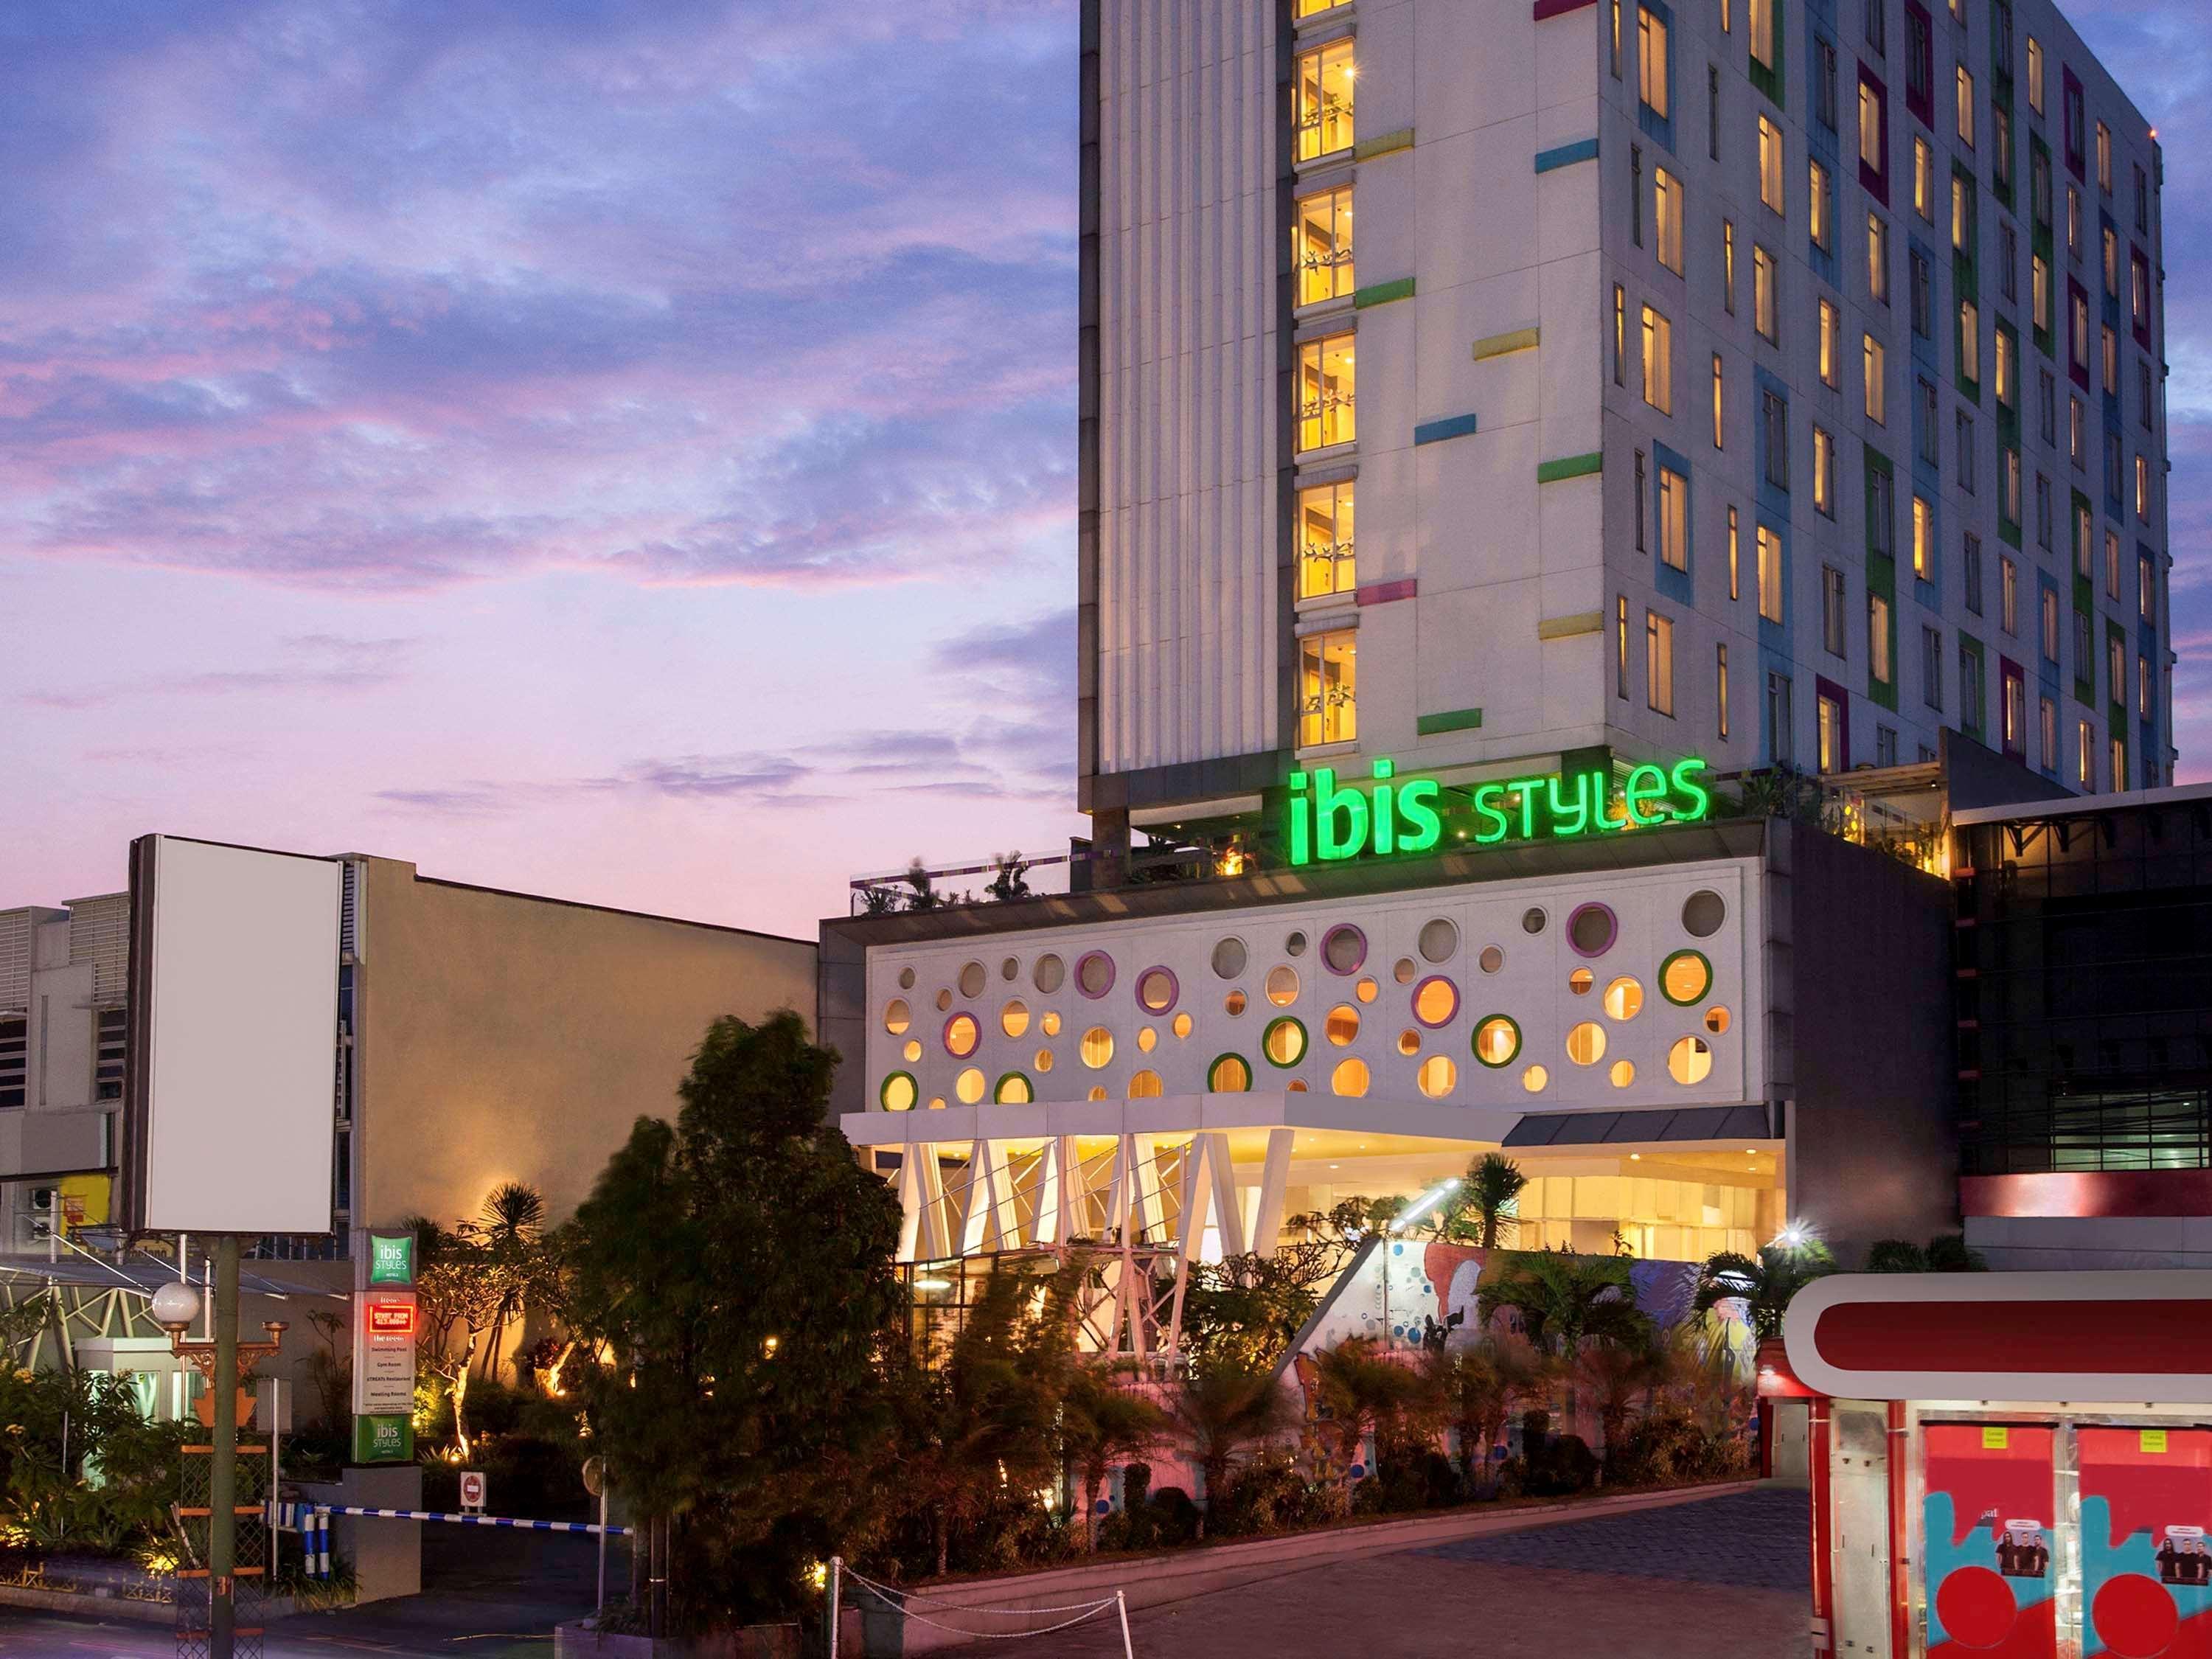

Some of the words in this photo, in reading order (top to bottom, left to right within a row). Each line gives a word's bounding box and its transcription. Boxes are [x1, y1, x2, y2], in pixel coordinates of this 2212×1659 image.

[1289, 759, 1441, 865] ibis
[380, 1245, 402, 1259] ibis
[377, 1424, 398, 1438] ibis
